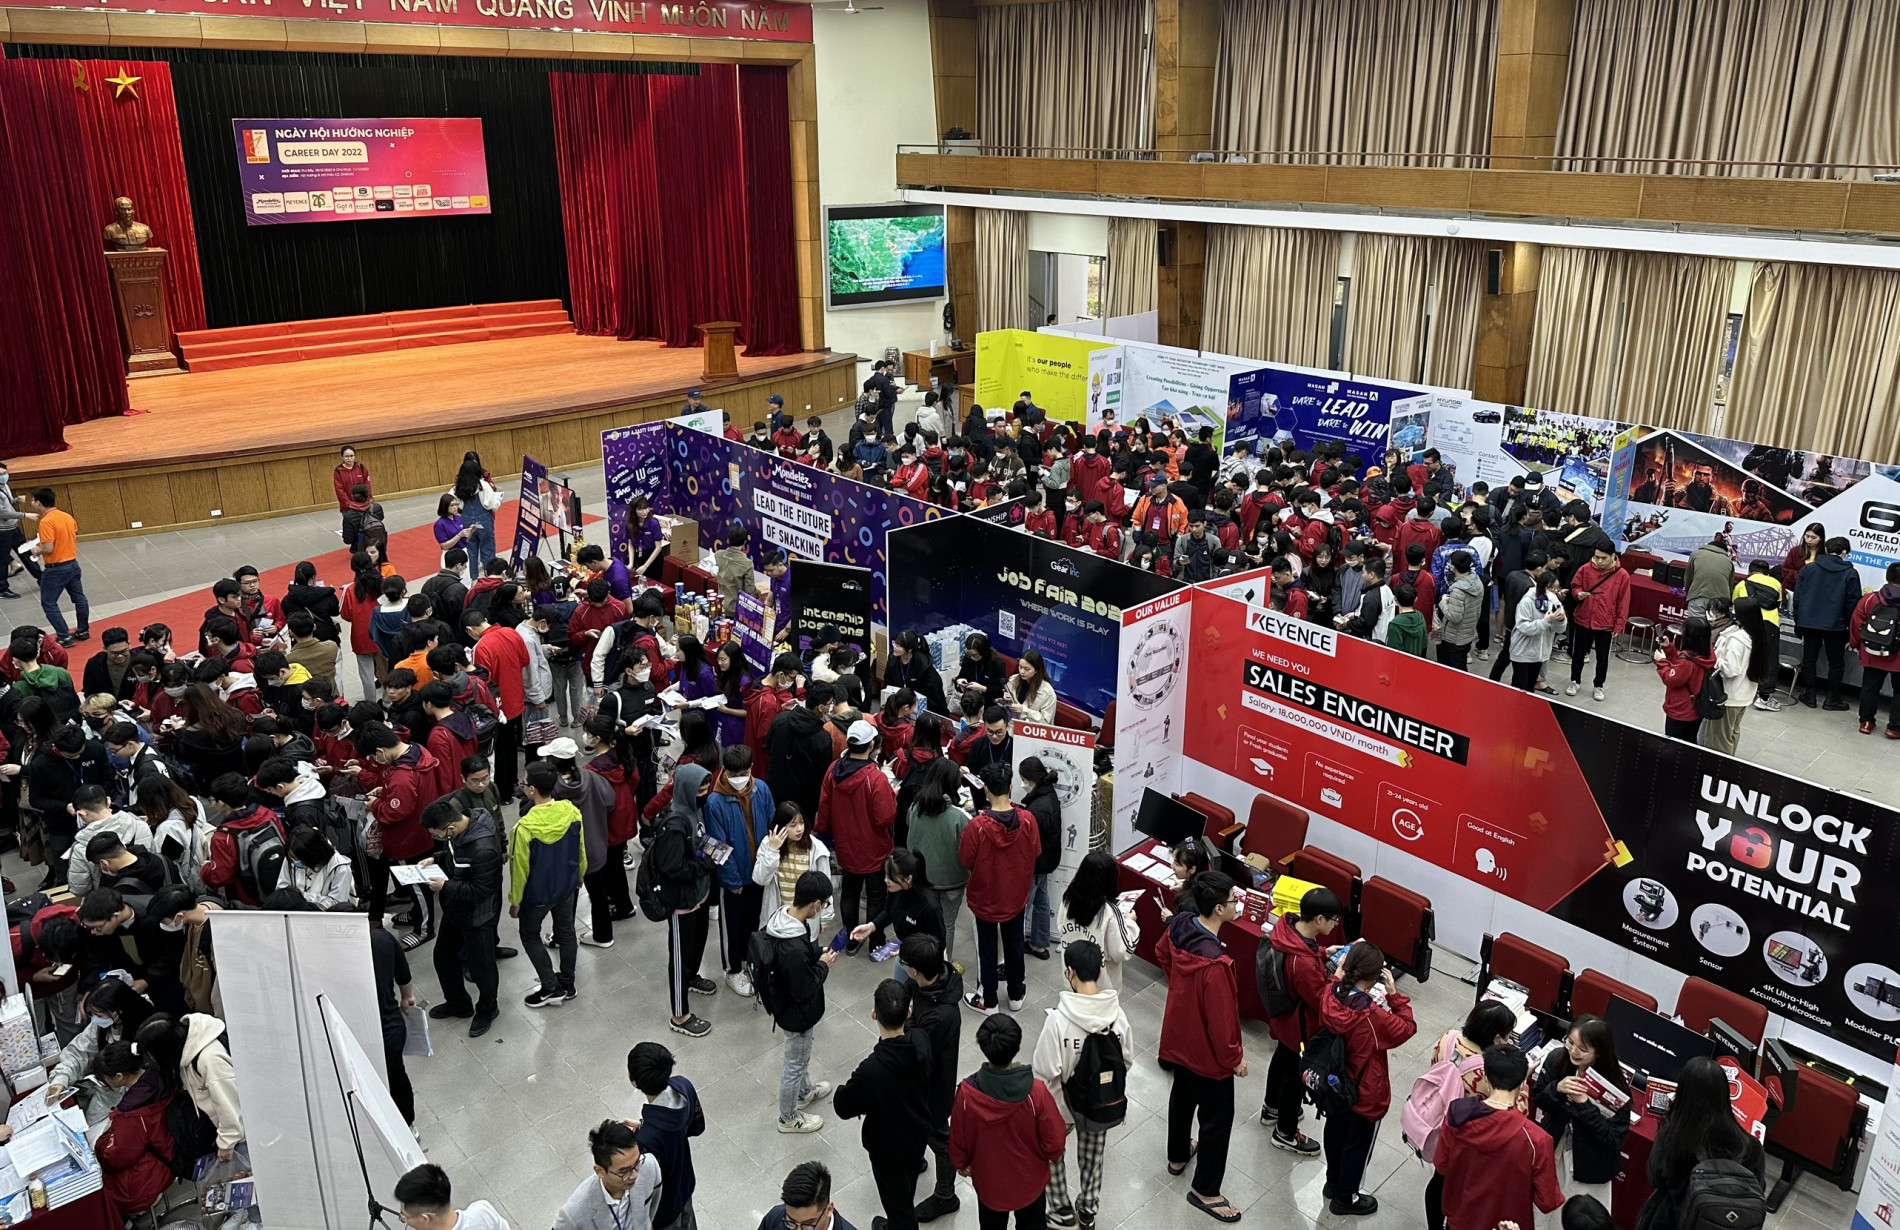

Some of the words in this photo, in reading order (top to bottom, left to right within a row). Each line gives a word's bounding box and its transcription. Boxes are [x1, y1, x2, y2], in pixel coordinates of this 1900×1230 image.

[475, 0, 574, 19] QUANG
[588, 0, 647, 24] VINH
[661, 4, 727, 29] MUÔN
[741, 5, 789, 32] NĂM
[275, 127, 307, 139] NGÀY
[309, 127, 330, 140] HỘI
[332, 126, 373, 138] HƯỚNG
[374, 127, 415, 139] NGHIỆP
[284, 148, 320, 157] CAREER
[321, 148, 339, 157] DAY
[341, 148, 362, 156] 2022
[1026, 366, 1040, 374] who
[1041, 369, 1058, 377] make
[1059, 371, 1070, 379] the
[1037, 357, 1048, 365] our
[1049, 358, 1072, 369] people
[1307, 382, 1326, 390] MASAN
[1346, 389, 1368, 397] MASAN
[1292, 396, 1316, 406] DARE
[1320, 397, 1369, 419] LEAD
[1317, 418, 1342, 429] DARE
[1348, 419, 1390, 440] WIN
[1478, 451, 1499, 460] Contact
[635, 467, 647, 482] LU
[614, 486, 631, 499] TANG
[756, 493, 776, 513] LEAD
[778, 501, 794, 520] THE
[797, 509, 830, 534] FUTURE
[766, 524, 776, 539] OF
[778, 529, 820, 558] SNACKING
[1849, 528, 1900, 546] GAMELO
[1860, 540, 1898, 554] VIETNAM
[1050, 561, 1069, 574] Gear
[1069, 566, 1080, 578] Inc
[1865, 556, 1882, 565] THE
[841, 582, 855, 590] Gear
[1020, 598, 1049, 616] WHERE
[1050, 608, 1076, 625] WORK
[1077, 618, 1085, 629] IS
[1086, 622, 1110, 637] PLAY
[1135, 604, 1153, 620] OUR
[1154, 594, 1181, 612] VALUE
[798, 618, 864, 637] posons
[1252, 612, 1332, 653] KEYENCE
[1252, 648, 1266, 660] WE
[1266, 653, 1290, 668] NEED
[1291, 661, 1311, 675] YOU
[1249, 665, 1317, 706] SALES
[1322, 690, 1455, 758] ENGINEER
[1022, 725, 1047, 739] OUR
[1051, 731, 1086, 746] VALUE
[1248, 695, 1277, 714] Salary:
[1278, 707, 1328, 733] 18,000,000
[1357, 738, 1389, 757] month
[1243, 731, 1256, 741] Final
[1255, 735, 1268, 747] year
[1268, 741, 1289, 754] students
[1249, 738, 1263, 751] Fresh
[1262, 745, 1288, 761] graduates
[1315, 760, 1324, 768] No
[1322, 772, 1346, 785] required
[1402, 796, 1418, 807] years
[1418, 803, 1429, 811] old
[1700, 774, 1872, 854] UNLOCK
[1399, 819, 1416, 831] AGE
[1467, 822, 1484, 834] Good
[1484, 829, 1492, 837] at
[1493, 832, 1515, 846] English
[1686, 851, 1851, 931] POTENTIAL
[1622, 922, 1670, 949] Measurement
[1632, 936, 1658, 953] System
[1699, 956, 1724, 971] Sensor
[1749, 987, 1786, 1008] Accuracy
[1787, 1003, 1832, 1027] Microscope
[1762, 983, 1775, 993] 4K
[1775, 988, 1819, 1012] Ultra-High
[1844, 1017, 1882, 1038] Modular
[1714, 1030, 1740, 1055] KEYENCE
